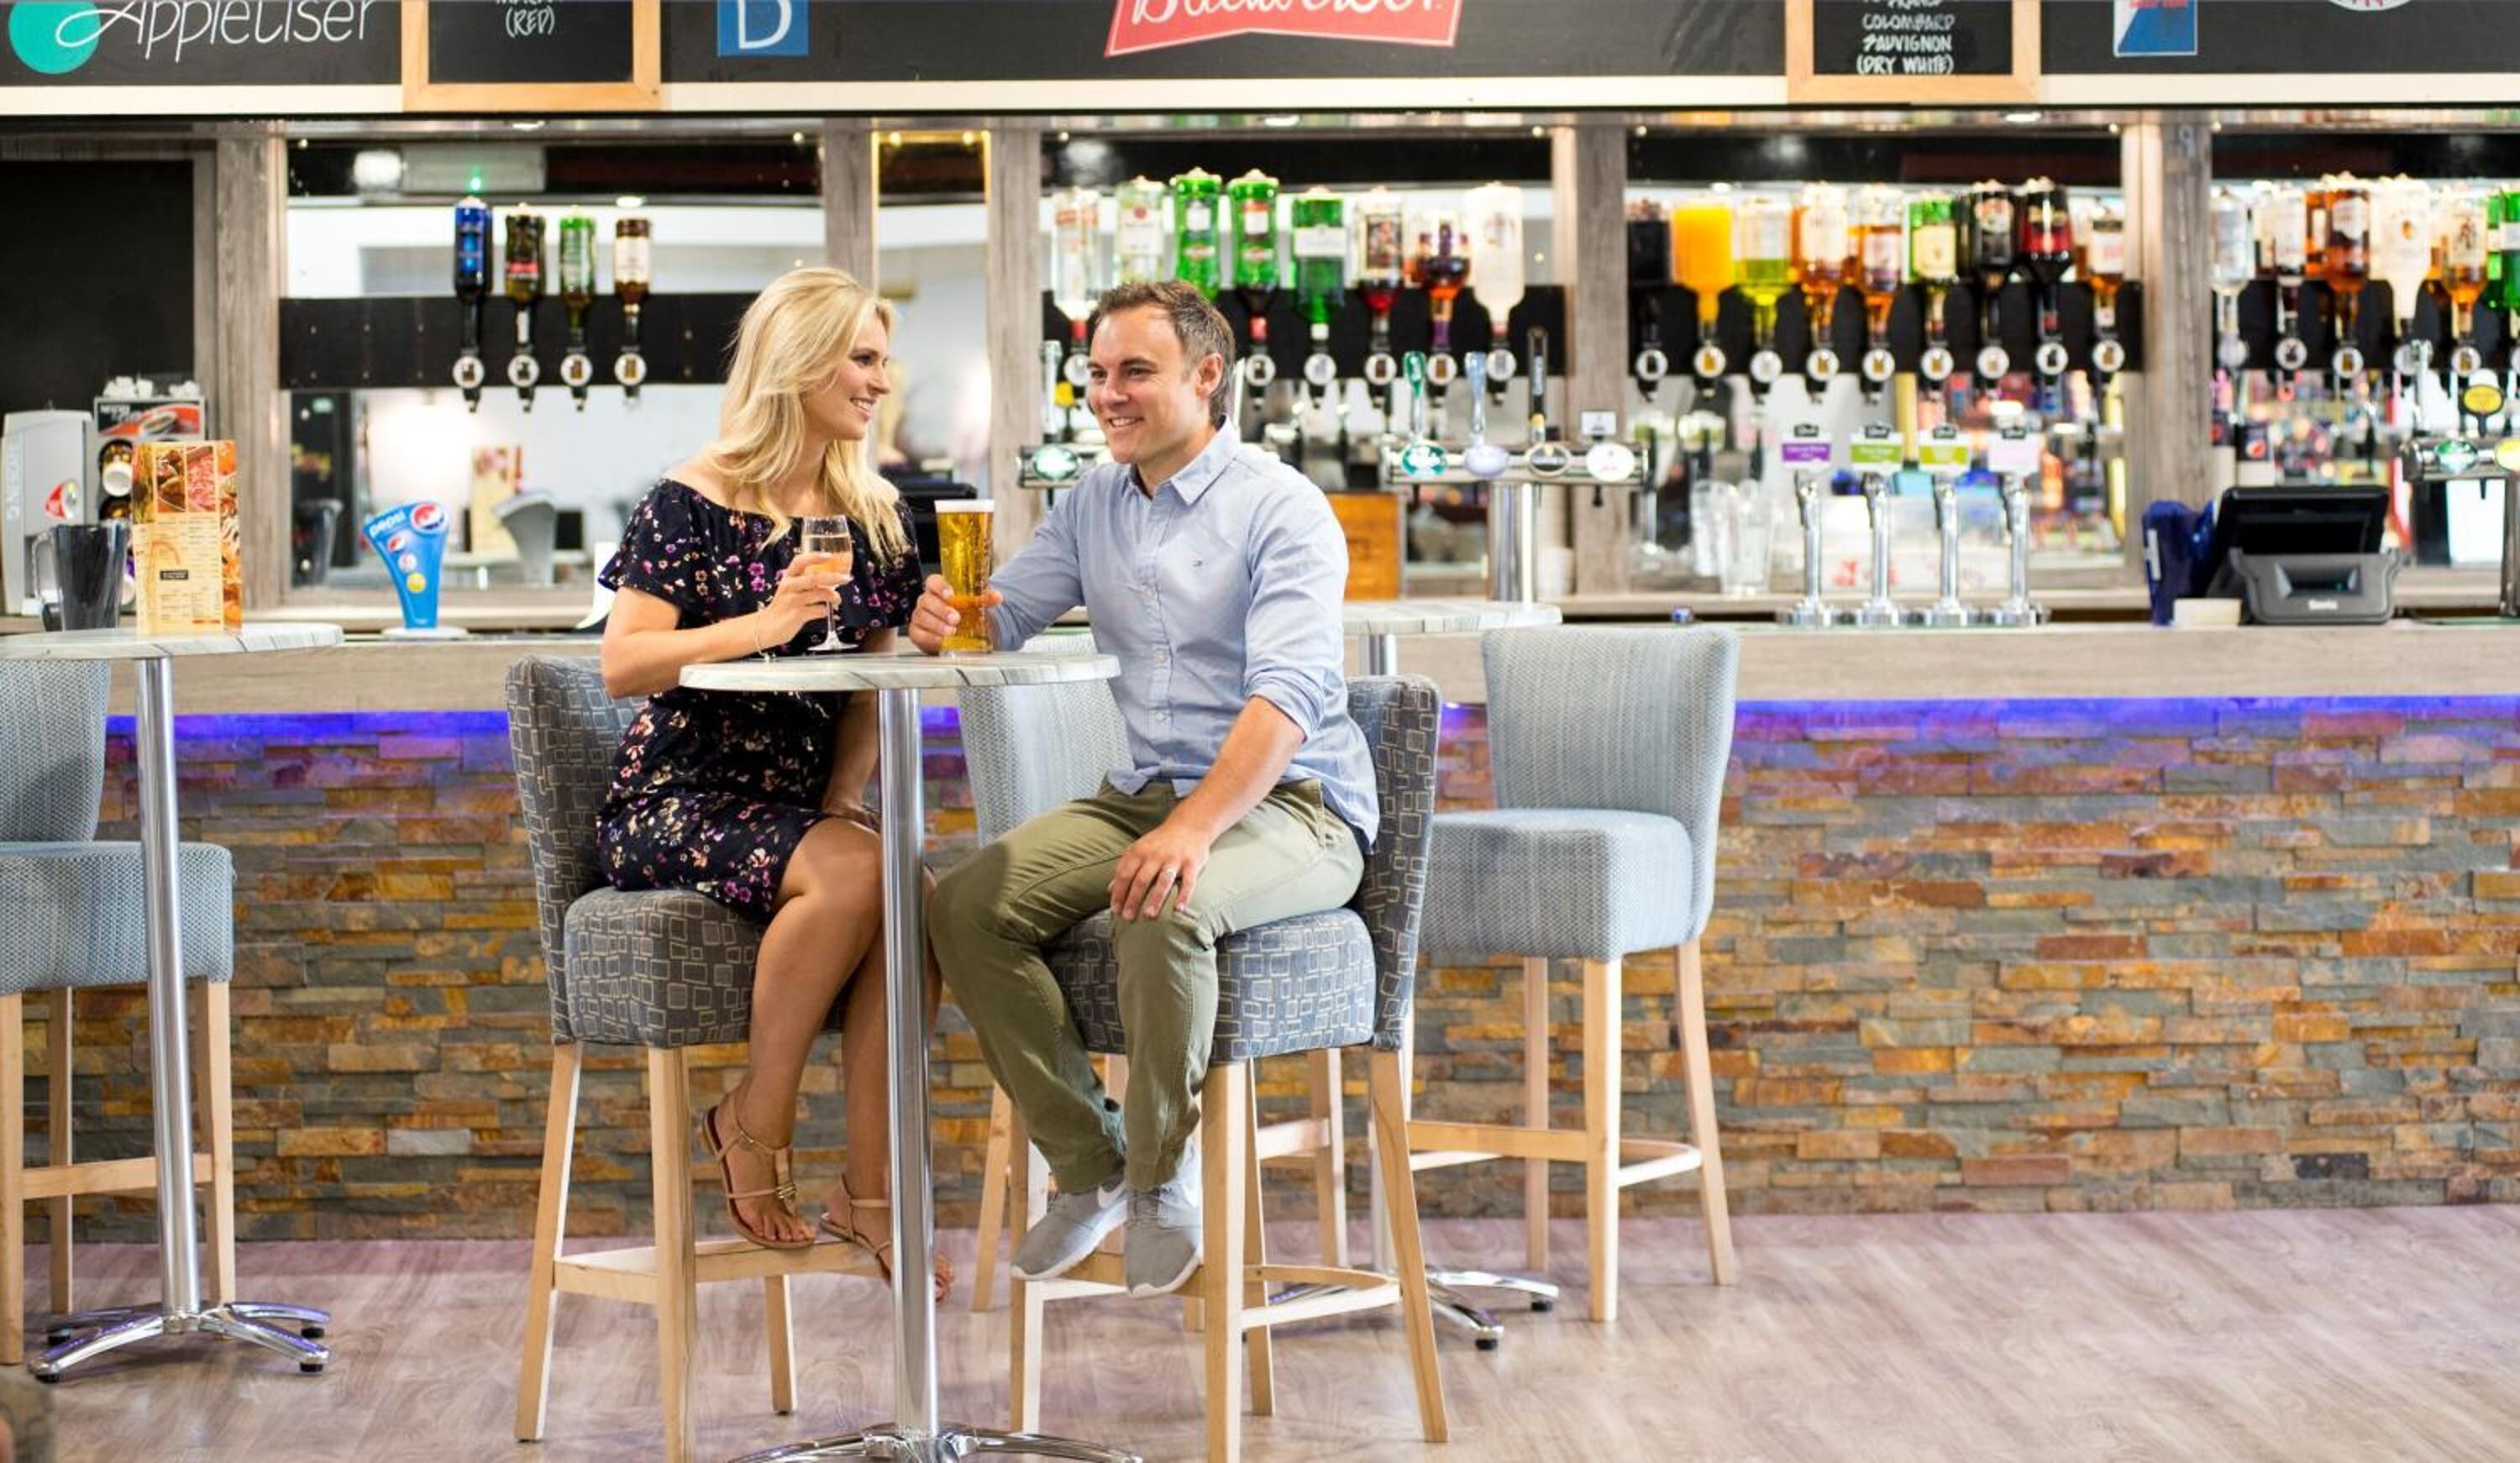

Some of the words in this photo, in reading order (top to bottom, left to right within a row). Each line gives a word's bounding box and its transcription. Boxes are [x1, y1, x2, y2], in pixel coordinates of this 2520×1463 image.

[505, 5, 555, 38] (RED)
[1861, 13, 1956, 31] COLOMBARD
[1862, 34, 1953, 52] SAUVIGNON
[1856, 54, 1897, 75] (DRY
[1902, 53, 1955, 75] WHITE)
